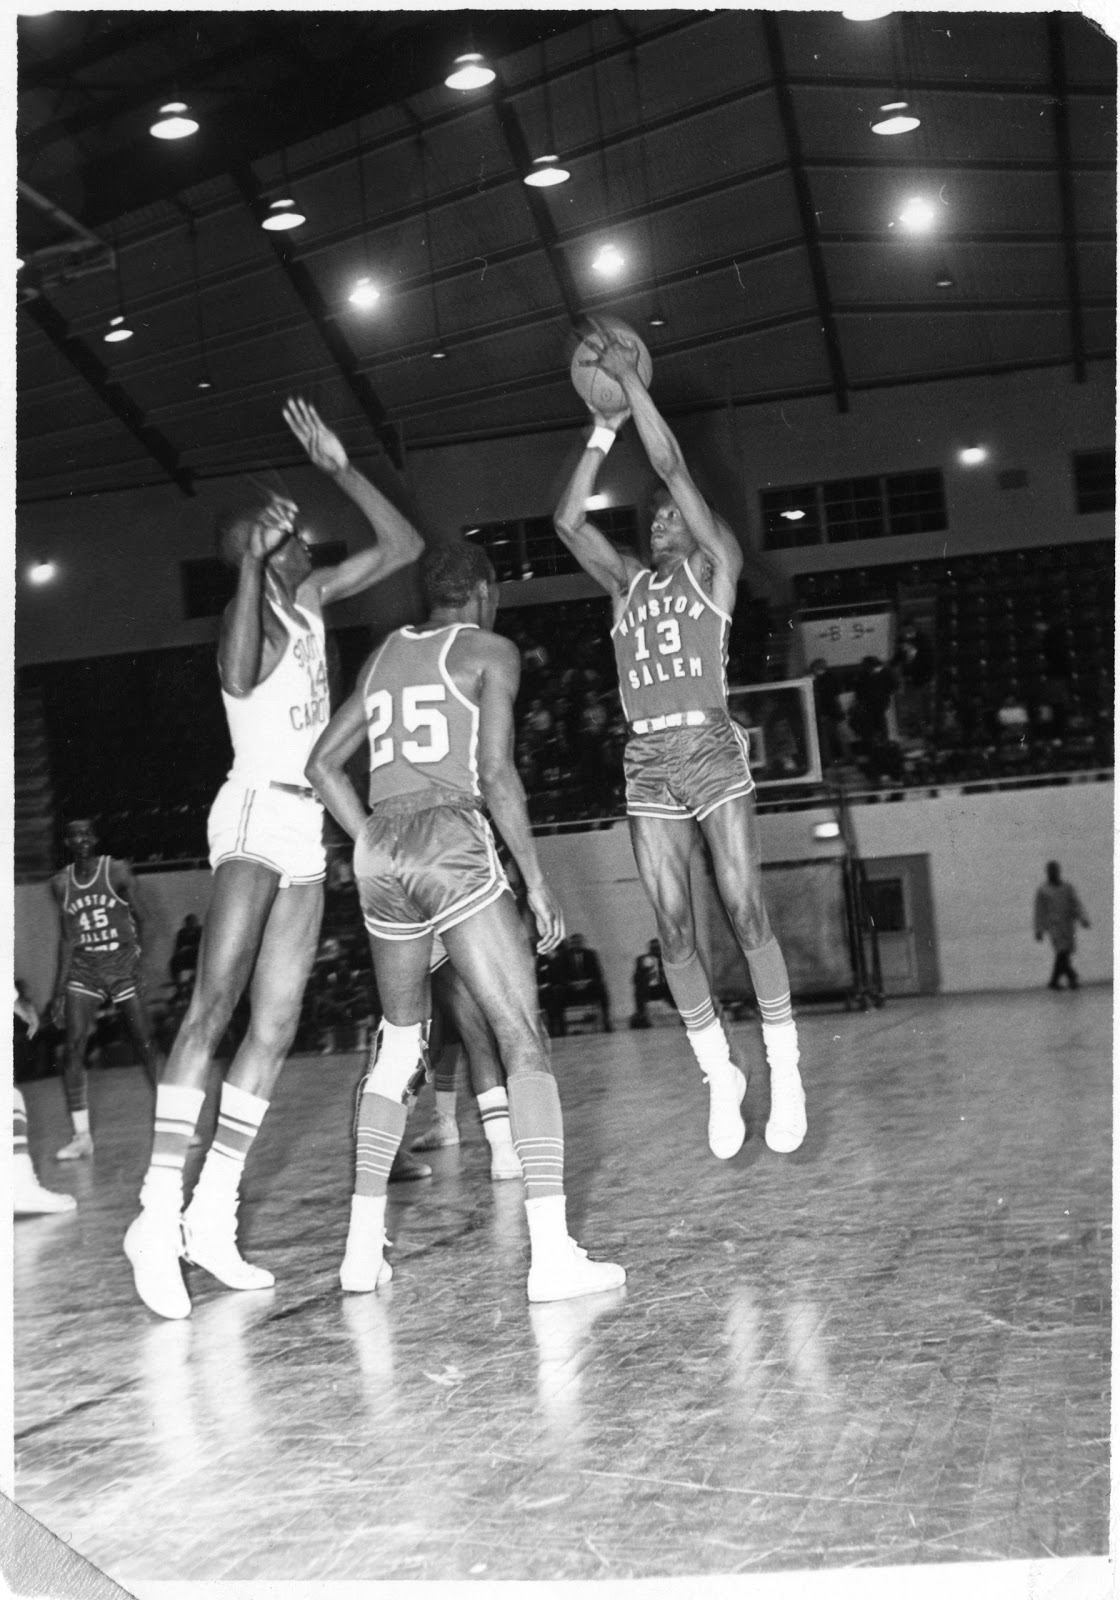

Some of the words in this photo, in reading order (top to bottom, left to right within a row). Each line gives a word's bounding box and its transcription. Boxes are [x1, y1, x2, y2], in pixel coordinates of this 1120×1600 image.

[634, 618, 682, 661] 13
[628, 657, 703, 689] SALEM
[366, 684, 449, 772] 25
[80, 908, 109, 930] 45
